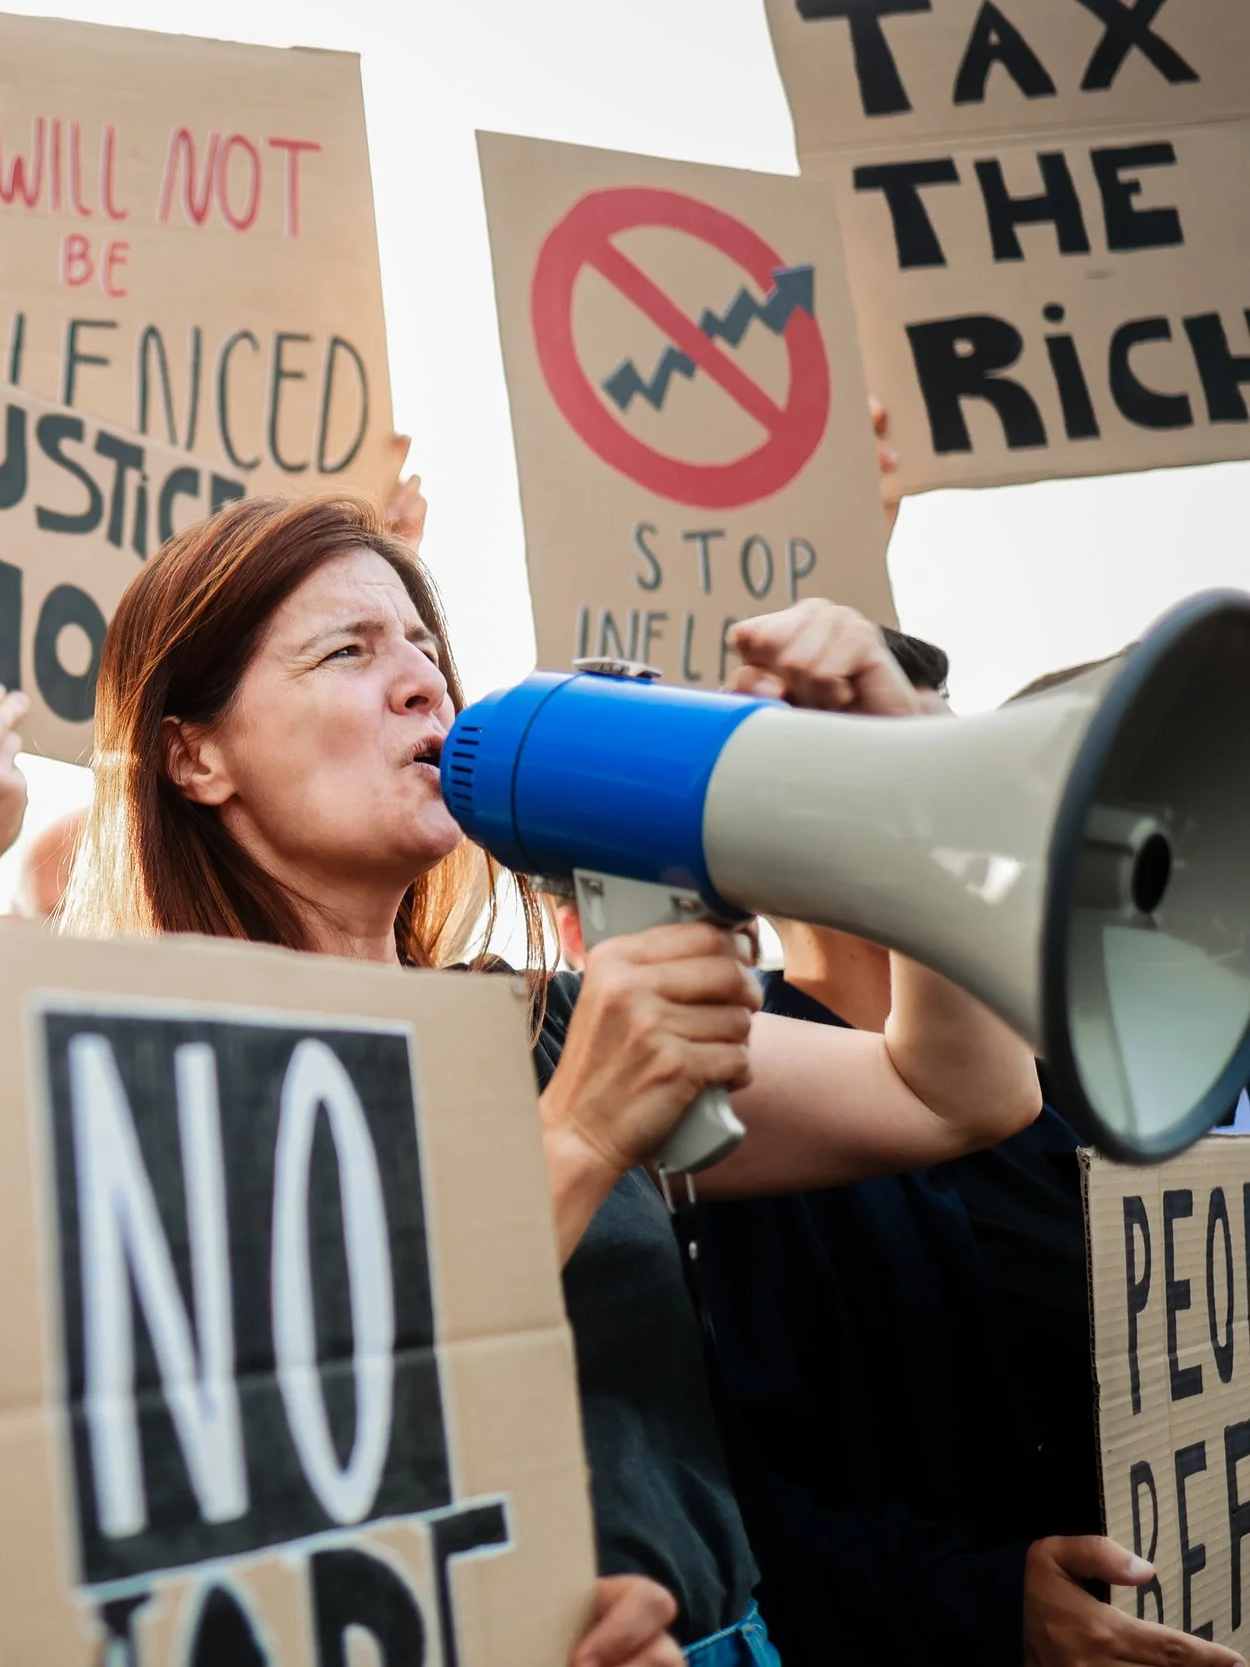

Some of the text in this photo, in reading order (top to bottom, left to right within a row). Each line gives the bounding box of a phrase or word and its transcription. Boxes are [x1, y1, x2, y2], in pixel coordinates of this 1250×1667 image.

[795, 0, 1200, 117] TAX
[158, 126, 323, 239] NOT
[852, 141, 1184, 271] THE
[61, 232, 131, 298] BE
[633, 521, 816, 601] STOP
[68, 1033, 395, 1538] NO
[1123, 1181, 1250, 1416] PEO
